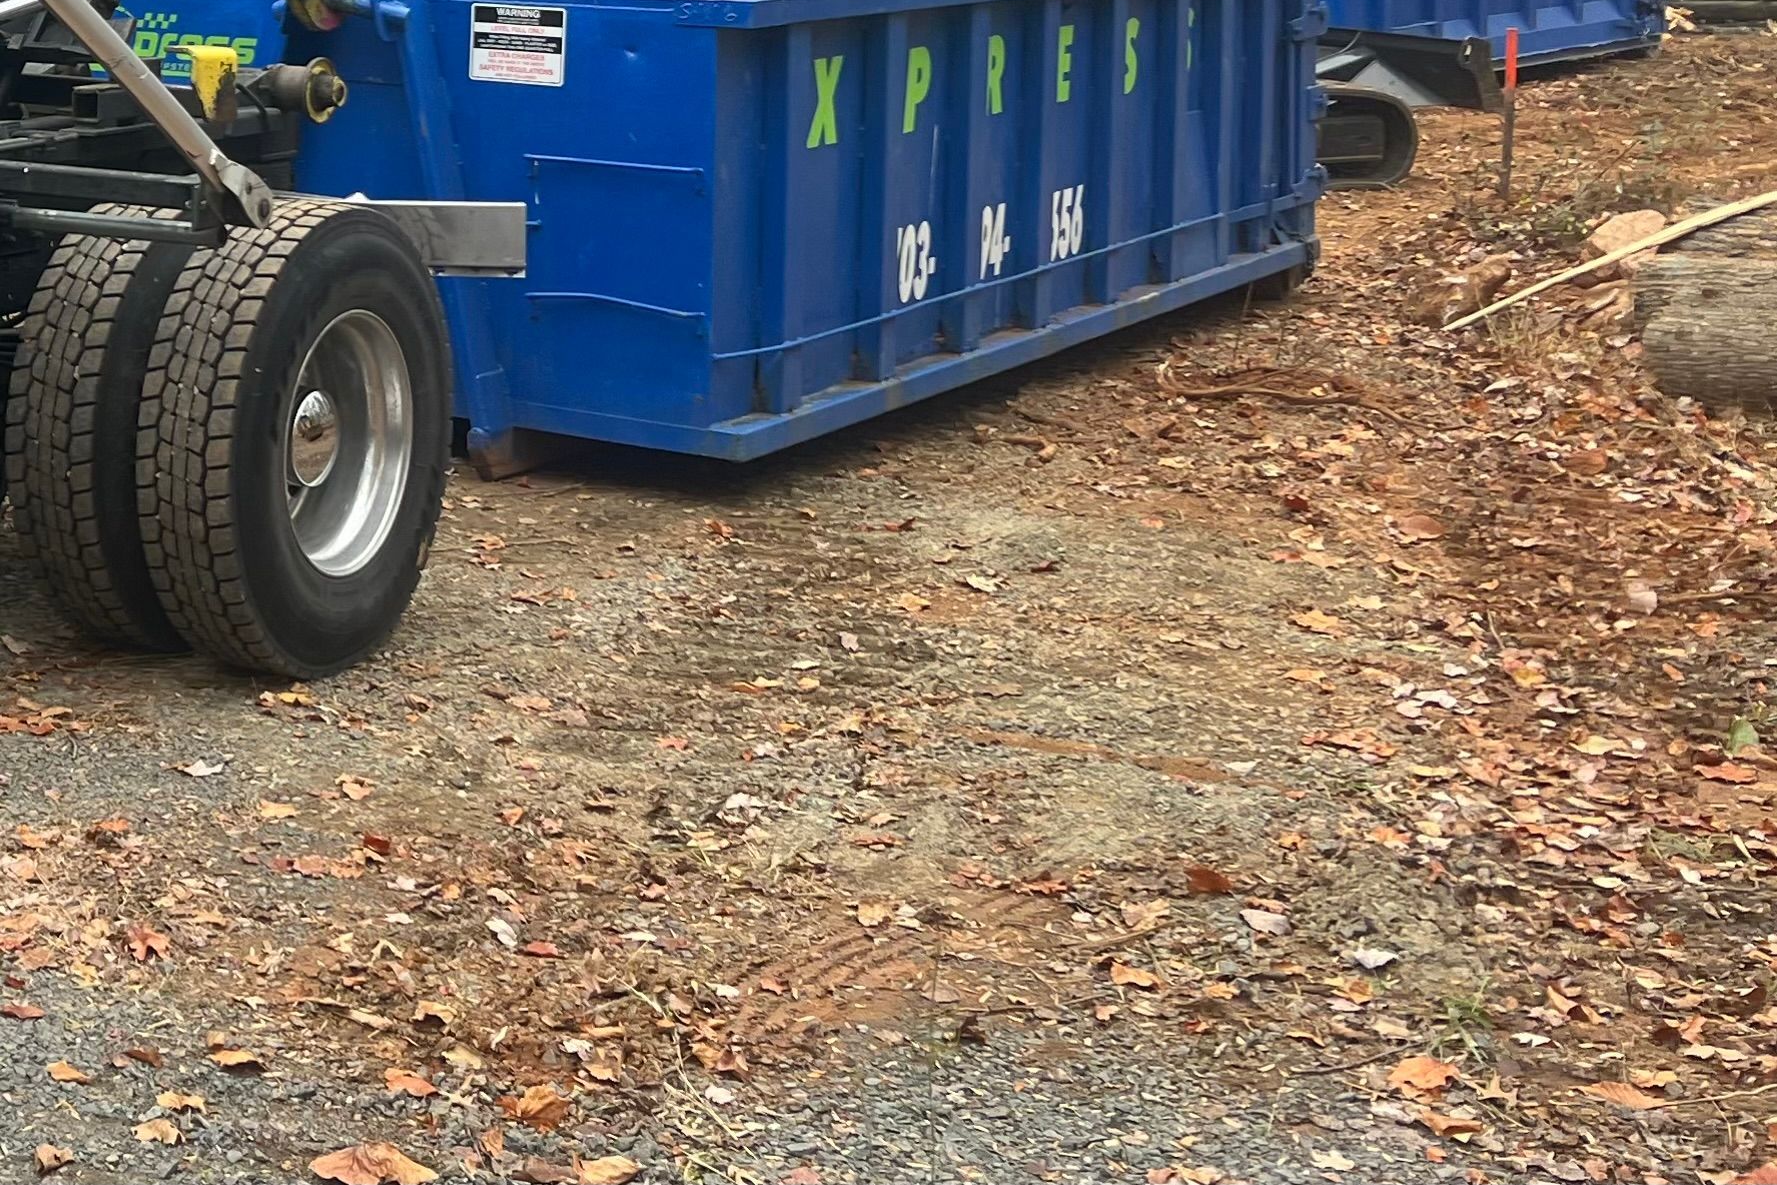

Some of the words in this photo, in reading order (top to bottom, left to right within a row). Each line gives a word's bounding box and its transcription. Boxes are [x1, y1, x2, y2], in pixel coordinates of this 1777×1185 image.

[496, 7, 541, 19] WARNING
[506, 66, 553, 76] REGULATIONS
[806, 7, 1195, 150] XPRES
